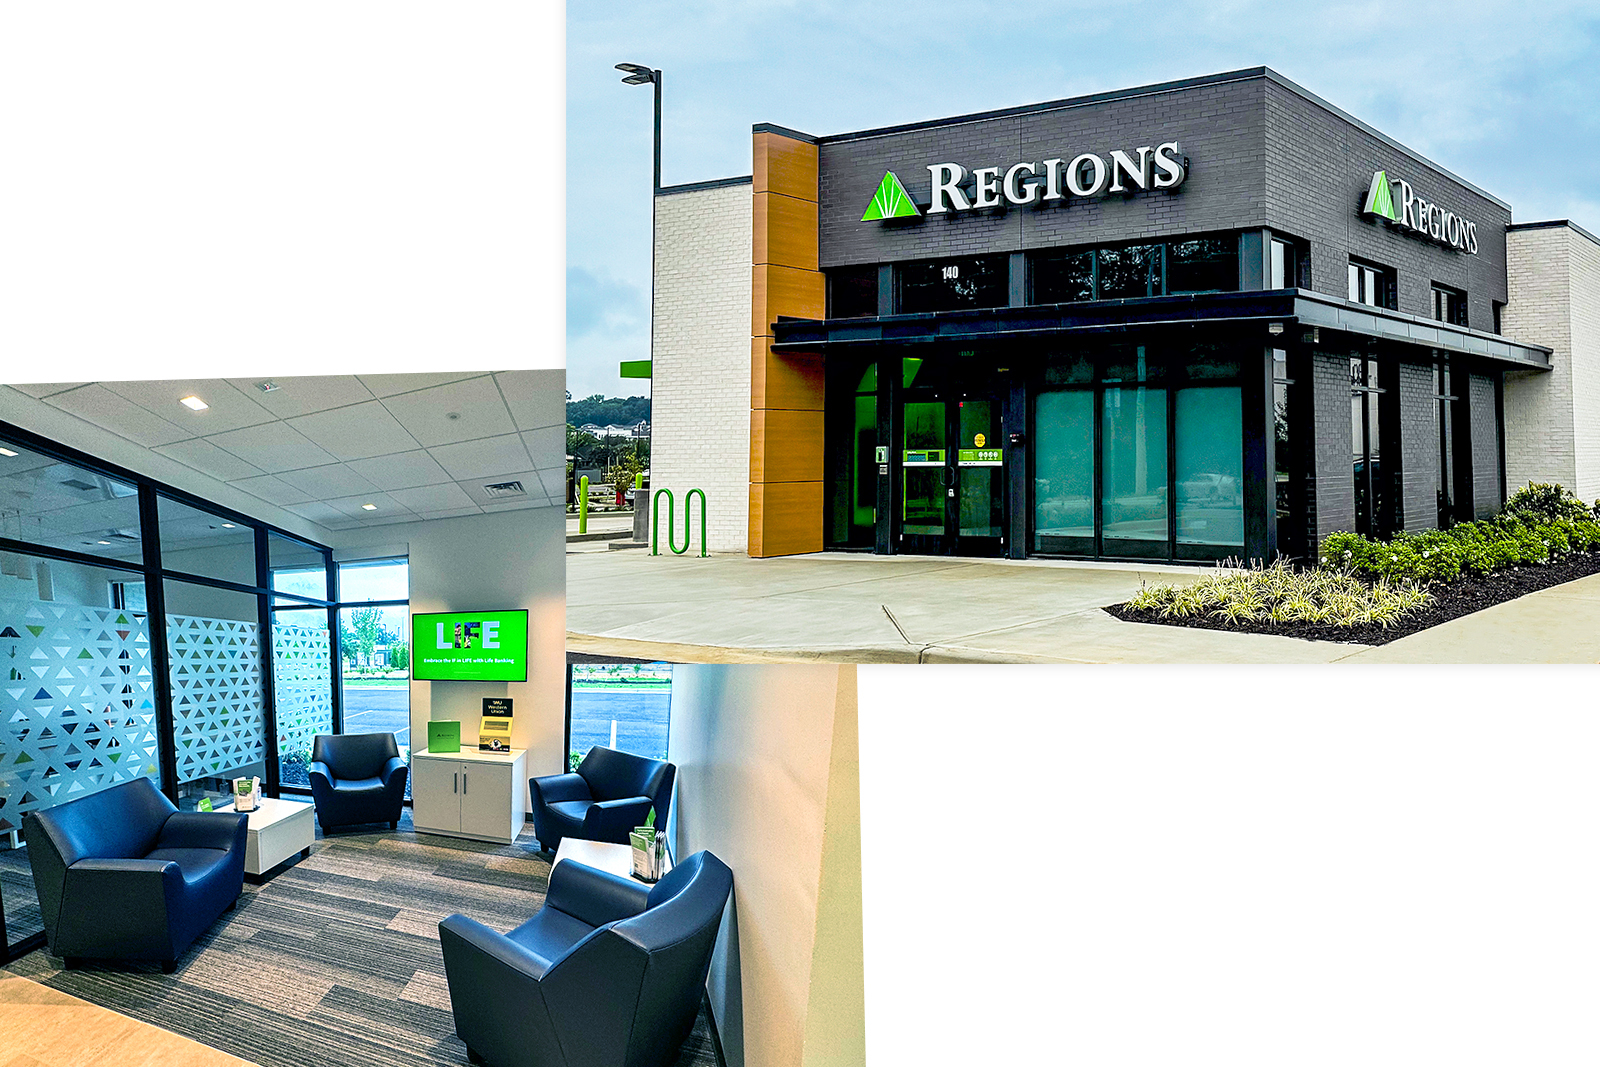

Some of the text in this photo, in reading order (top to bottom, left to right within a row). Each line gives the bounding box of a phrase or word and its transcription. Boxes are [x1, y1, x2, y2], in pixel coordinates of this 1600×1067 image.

[926, 141, 1184, 214] REGIONS
[1396, 178, 1478, 255] REGIONS
[941, 265, 959, 280] 140
[436, 621, 500, 650] LIFE
